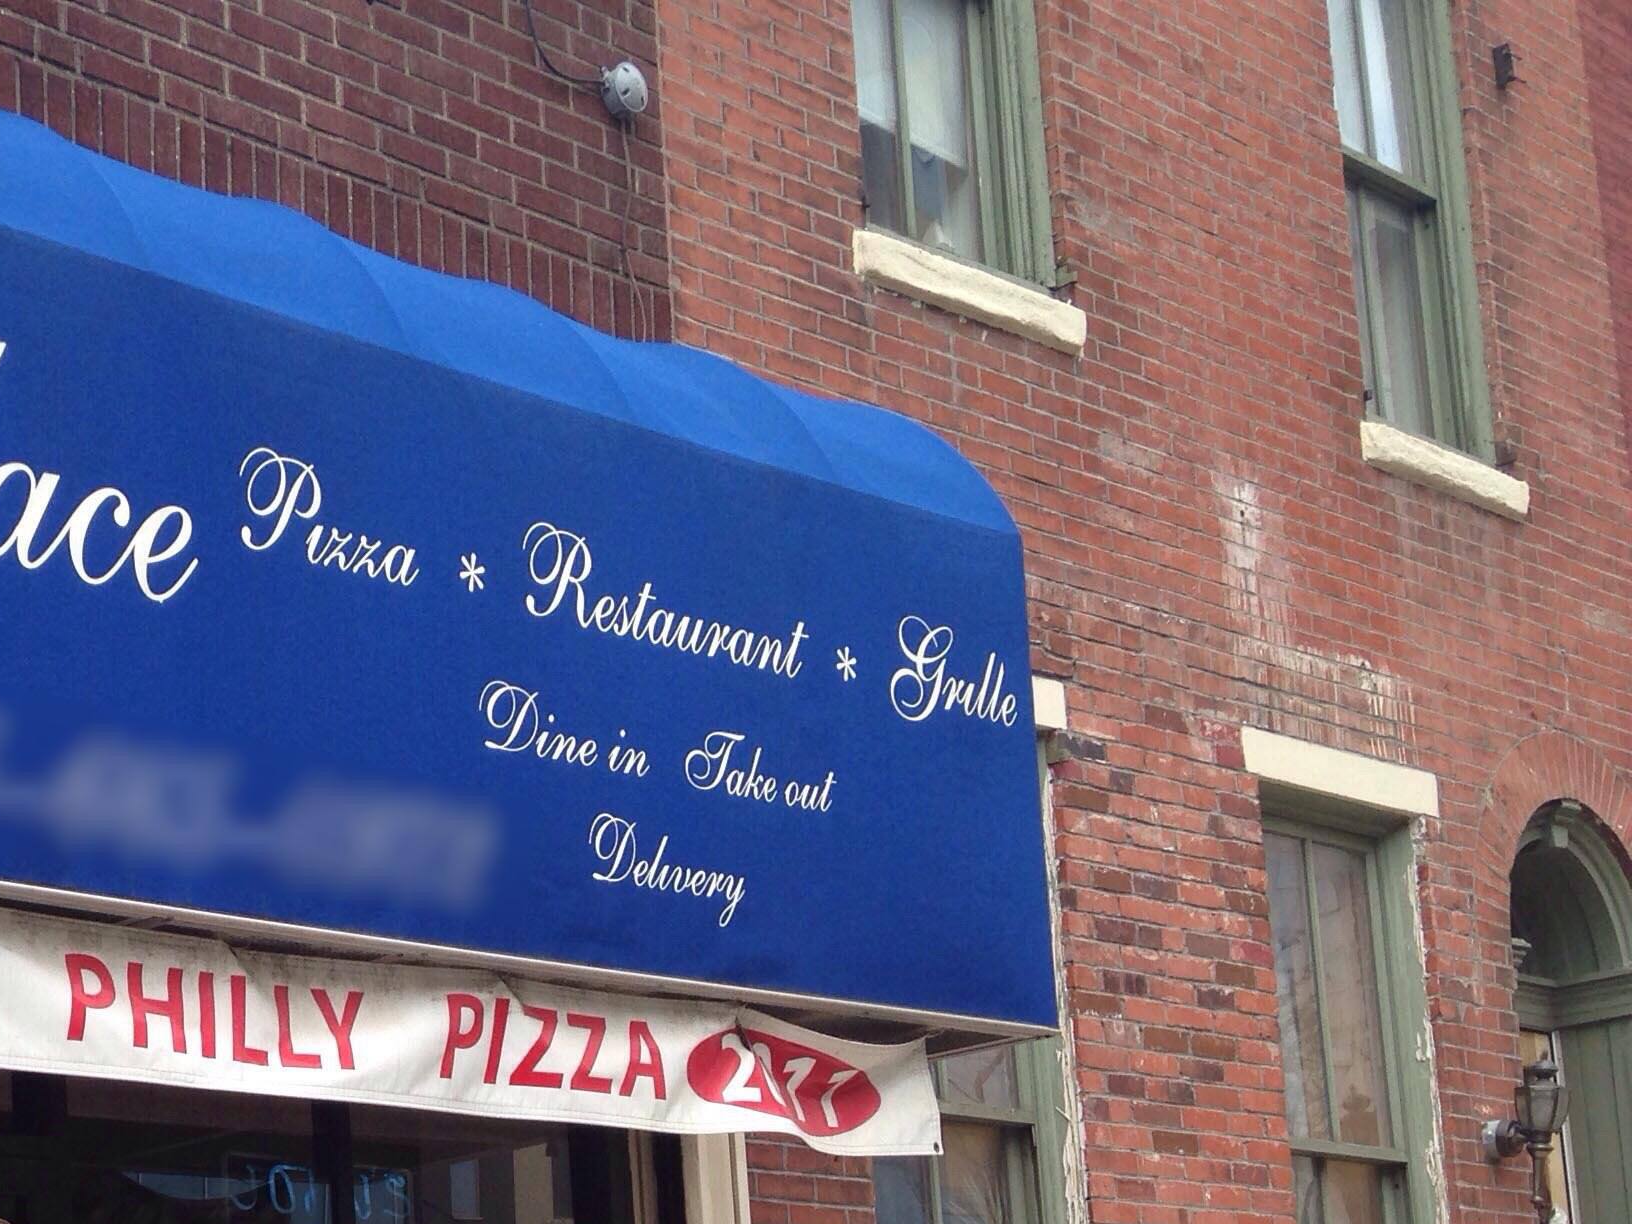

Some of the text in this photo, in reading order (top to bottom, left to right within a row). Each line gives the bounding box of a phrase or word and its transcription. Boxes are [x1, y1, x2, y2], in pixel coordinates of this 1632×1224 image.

[240, 448, 1017, 726] Pizza Restaurant Grille
[479, 681, 836, 811] Dine in Take out
[589, 814, 744, 926] Delivery
[65, 954, 364, 1070] PHILLY
[440, 993, 667, 1100] PIZZA
